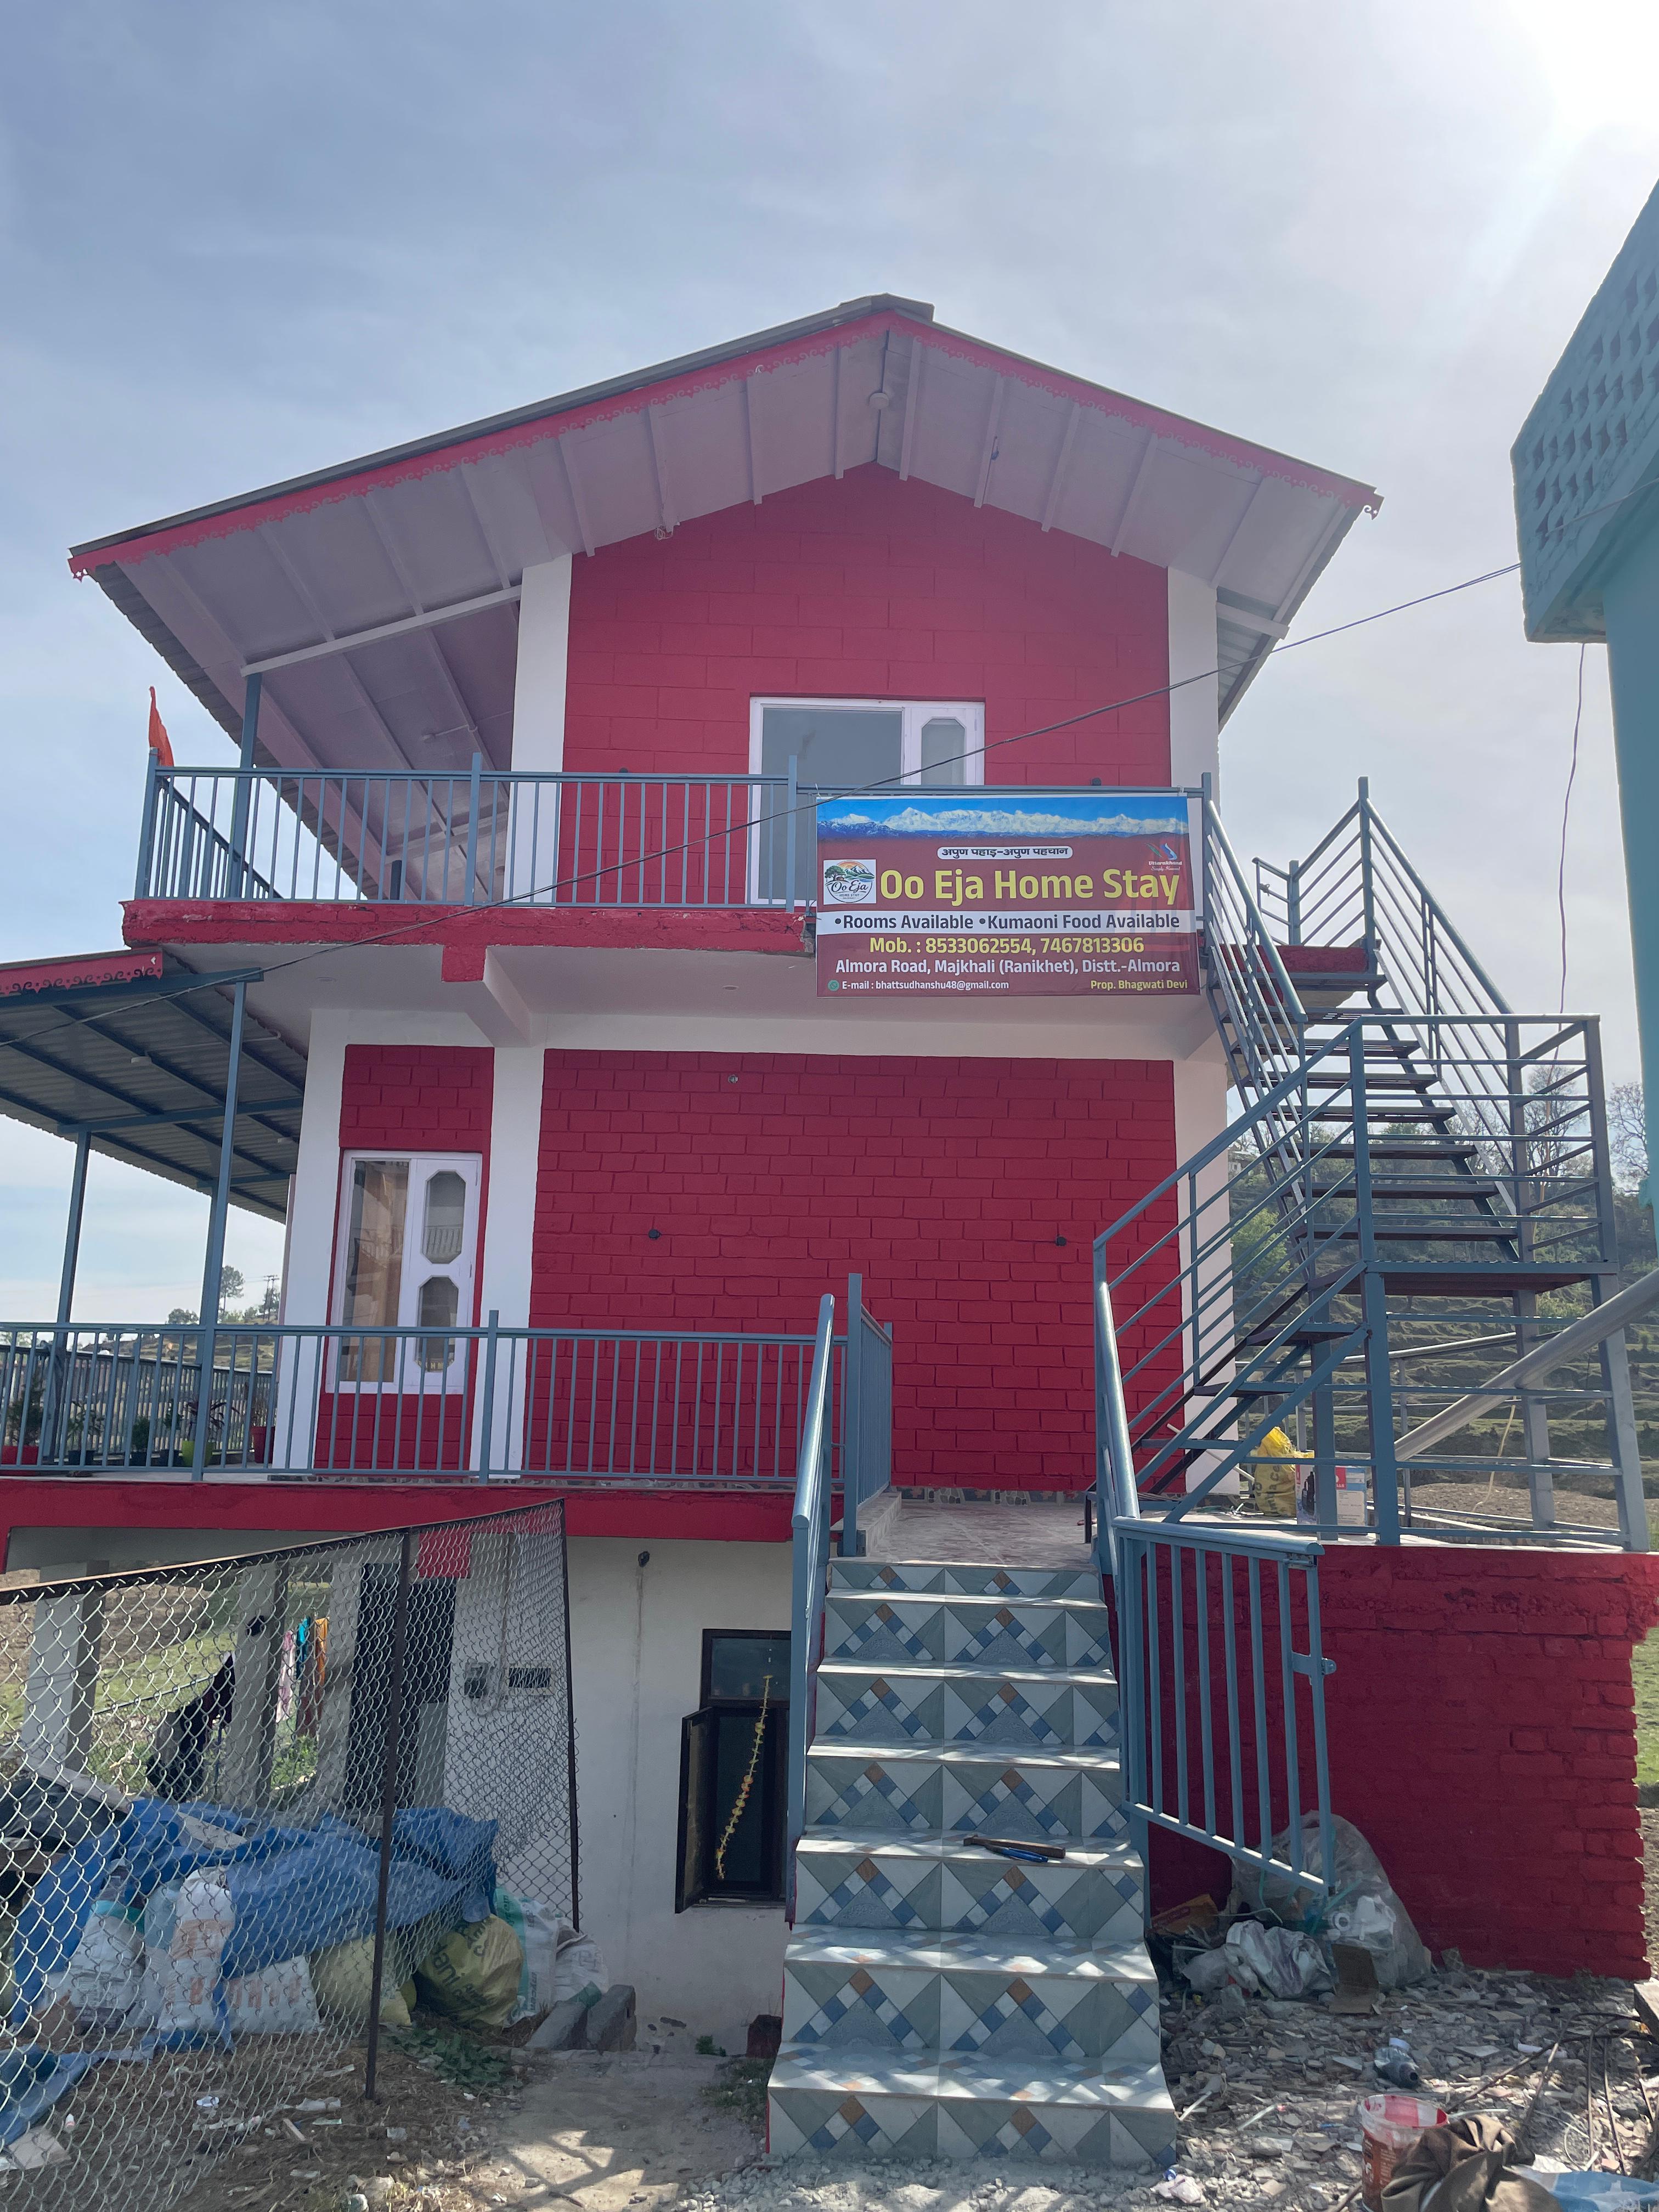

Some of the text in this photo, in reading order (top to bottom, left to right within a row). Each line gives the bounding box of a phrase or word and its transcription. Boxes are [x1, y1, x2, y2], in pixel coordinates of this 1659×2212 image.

[941, 849, 968, 859] अपुण
[831, 879, 868, 893] Oo Eja
[881, 868, 1180, 907] Oo Eja Home Stay
[843, 913, 1180, 929] Rooms Available Kumaoni Food Available
[870, 937, 912, 953] Mob.
[926, 937, 1036, 955] 8533062554,
[1040, 937, 1144, 953] 7467813306
[836, 958, 1180, 976] Almora Road, Majkhali (Ranikhet), Distt.-Almora
[842, 981, 870, 989] E-mail
[876, 980, 1009, 991] bhattsudhanshu48@gmail.com
[1091, 979, 1188, 991] Prop. Bhagwati Devi
